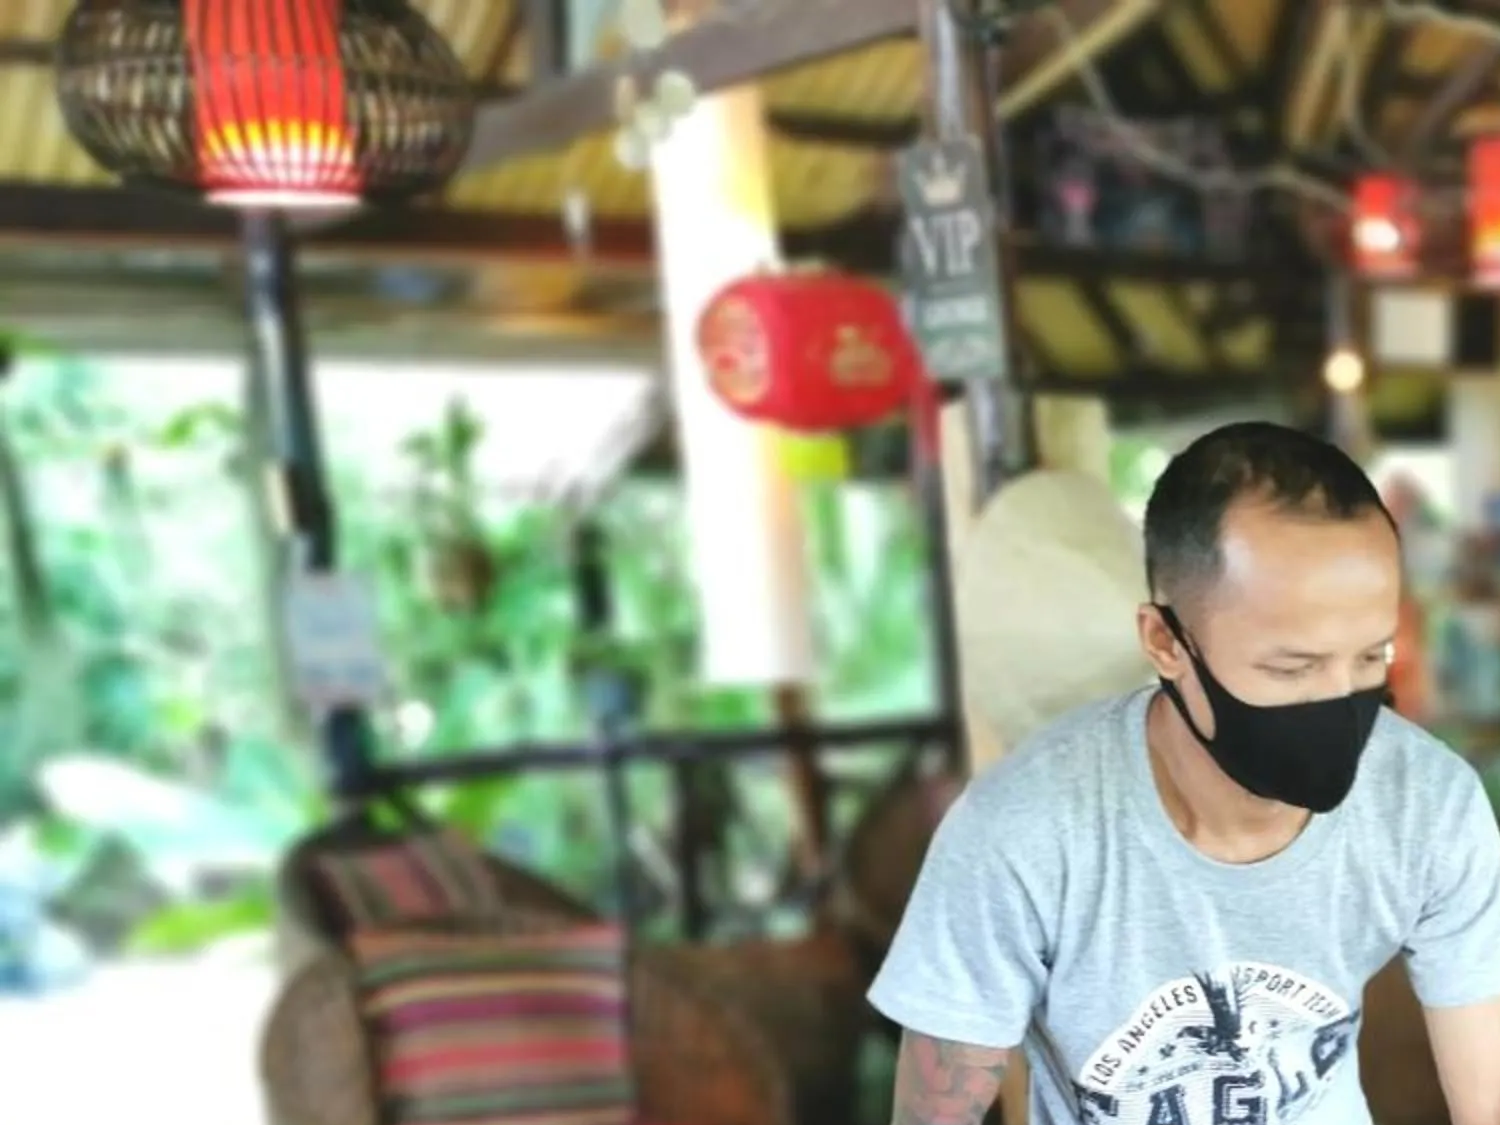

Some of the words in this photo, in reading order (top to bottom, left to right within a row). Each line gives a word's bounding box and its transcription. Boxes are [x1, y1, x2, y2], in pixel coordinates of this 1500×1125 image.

[911, 209, 980, 276] VIP
[1088, 1054, 1121, 1086] LOS
[1117, 985, 1198, 1054] ANGELES
